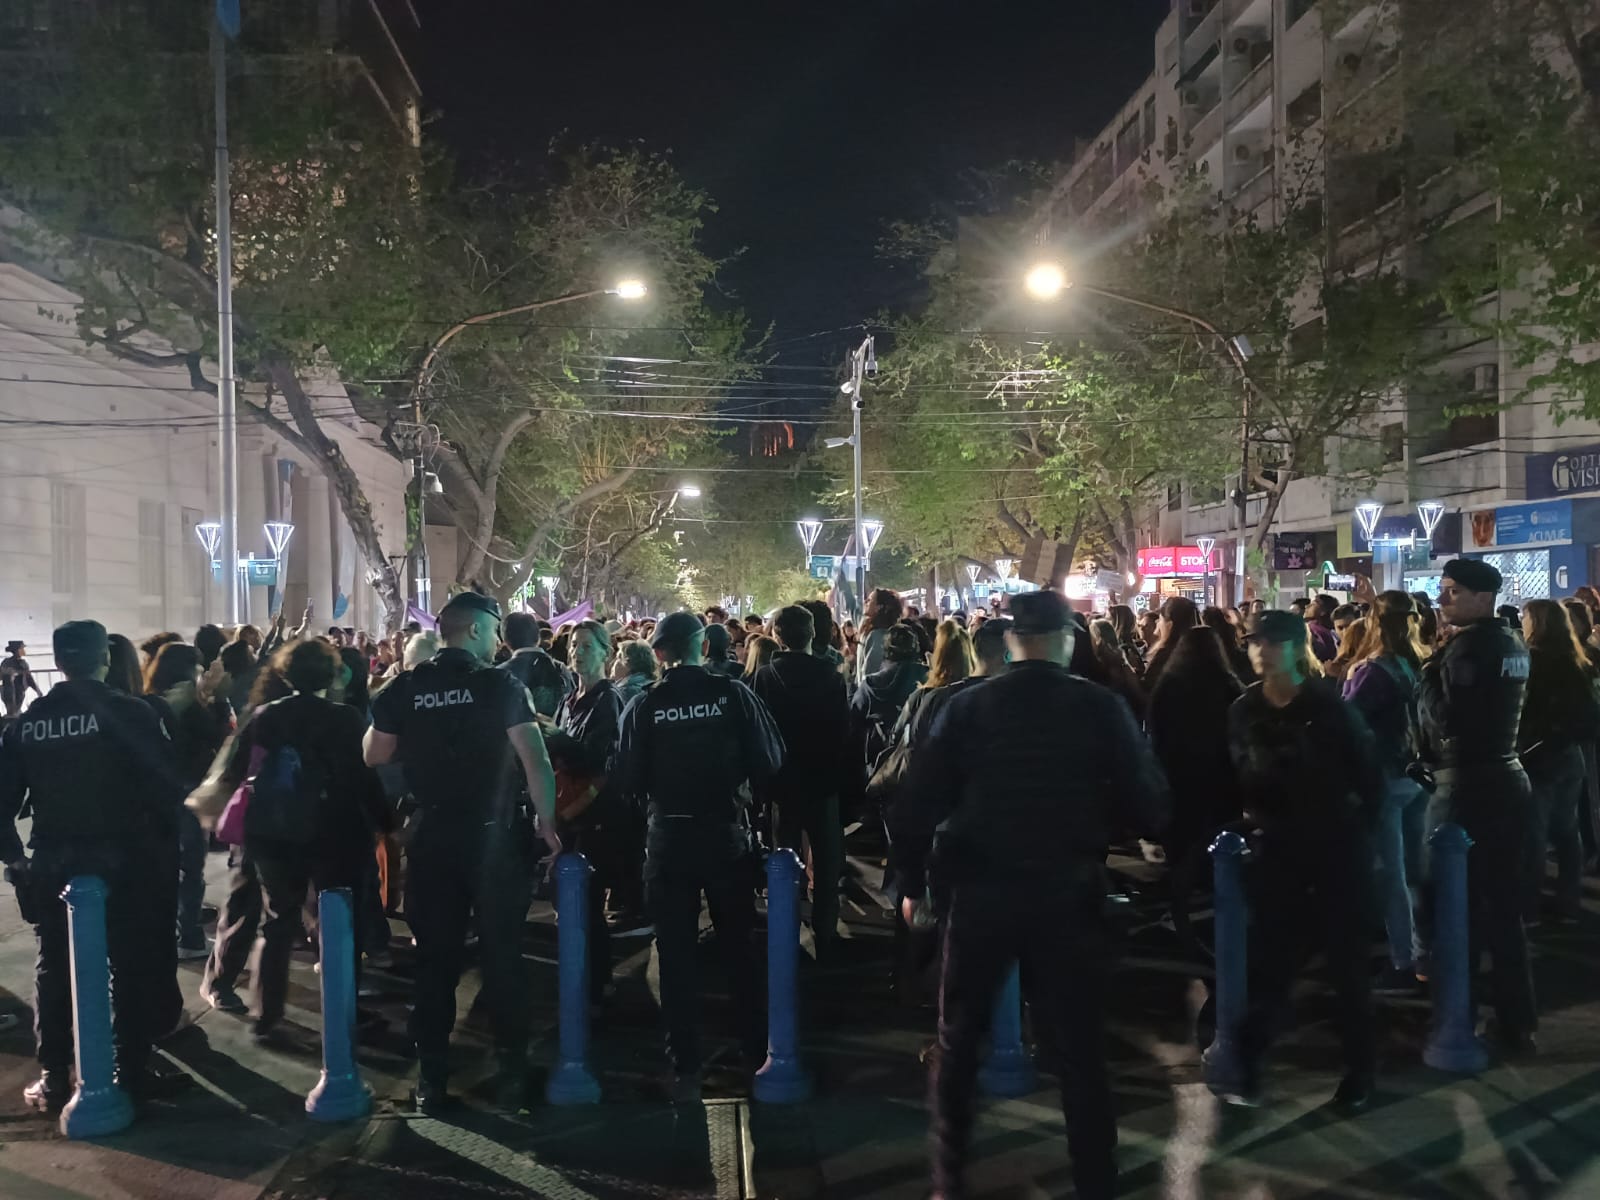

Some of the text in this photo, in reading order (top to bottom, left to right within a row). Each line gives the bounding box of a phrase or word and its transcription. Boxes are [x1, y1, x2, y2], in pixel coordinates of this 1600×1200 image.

[413, 688, 474, 710] POLICIA
[655, 703, 722, 724] POLICIA
[20, 711, 99, 742] POLICIA
